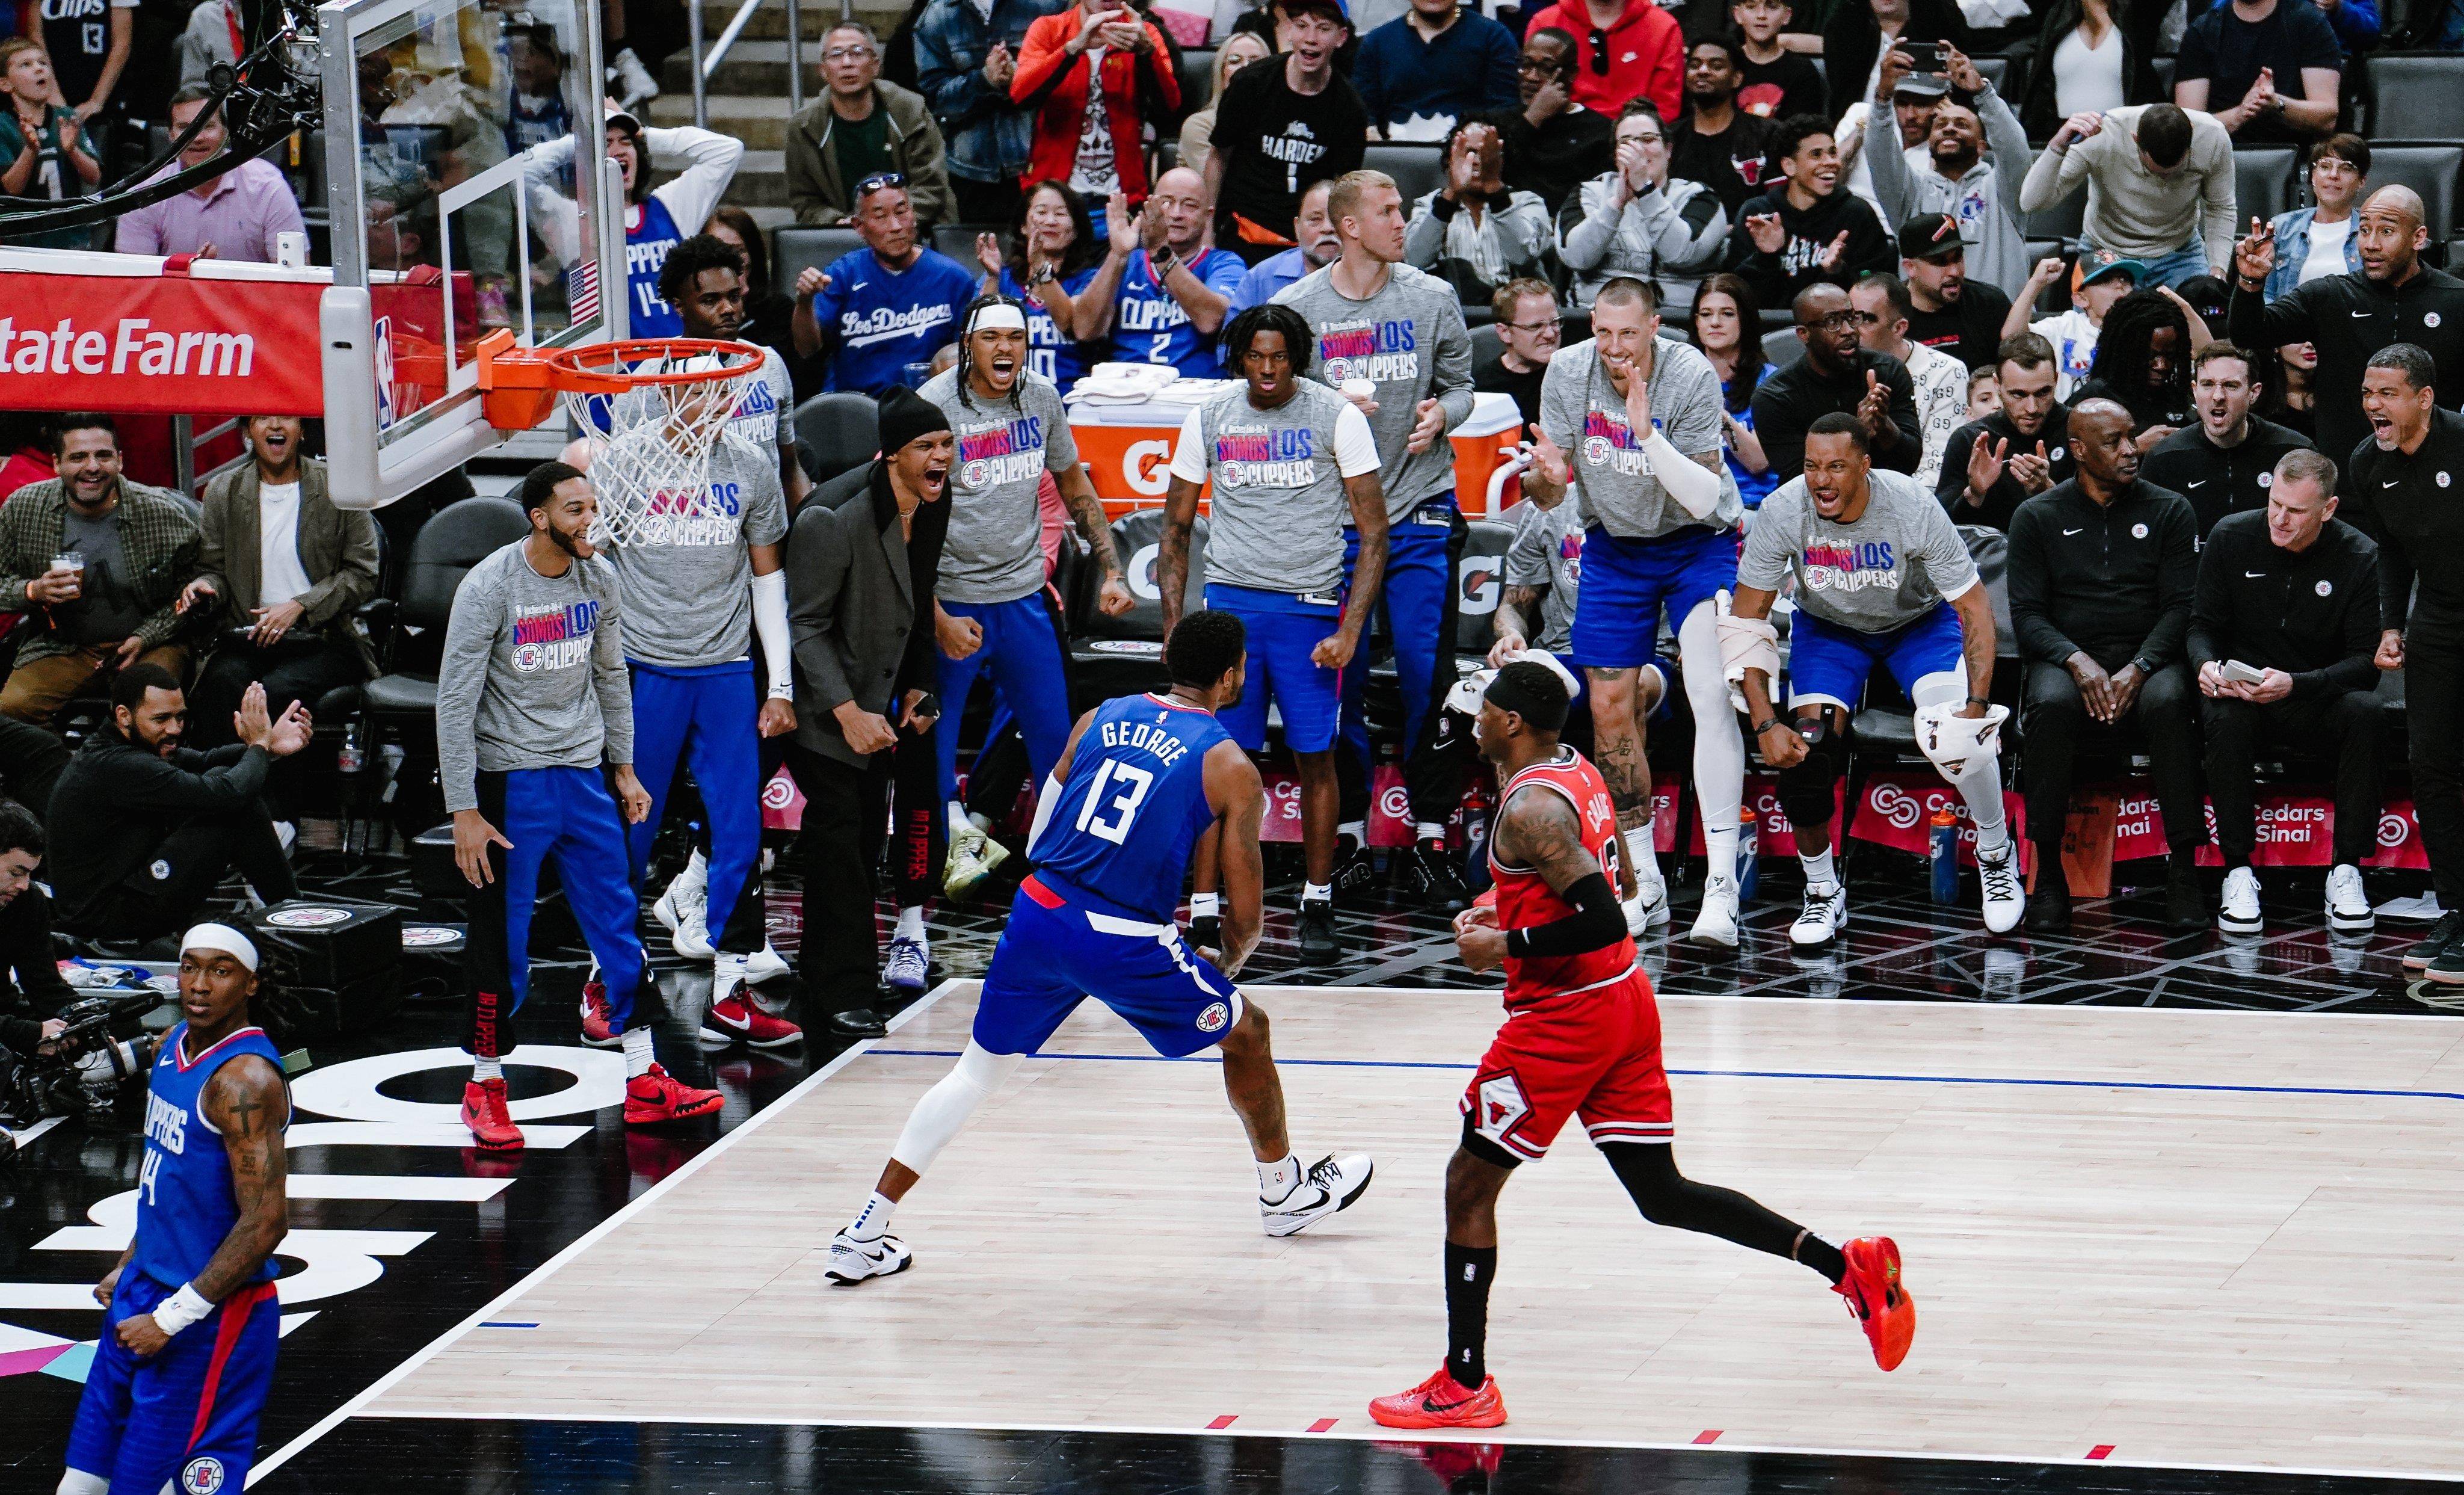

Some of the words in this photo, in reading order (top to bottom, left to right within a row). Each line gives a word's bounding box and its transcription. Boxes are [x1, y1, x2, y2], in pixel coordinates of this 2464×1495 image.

[636, 282, 670, 317] 14
[840, 310, 872, 336] Los
[871, 303, 953, 339] Dodgers
[1375, 319, 1415, 353] LOS
[0, 316, 107, 375] tate
[111, 318, 254, 377] Farm
[1149, 333, 1172, 364] 2
[1009, 416, 1042, 453] LOS
[1271, 428, 1313, 461] LOS
[990, 449, 1046, 485] CLIPPERS
[1123, 440, 1171, 495] G
[1246, 459, 1316, 488] CLIPPERS
[1854, 541, 1895, 570] LOS
[1458, 555, 1504, 615] G
[1834, 567, 1899, 593] CLIPPERS
[513, 612, 566, 646] SOMOS
[564, 600, 600, 639] LOS
[1101, 721, 1188, 767] GEORGE
[1076, 757, 1154, 845] 13
[2255, 824, 2311, 842] Sinai
